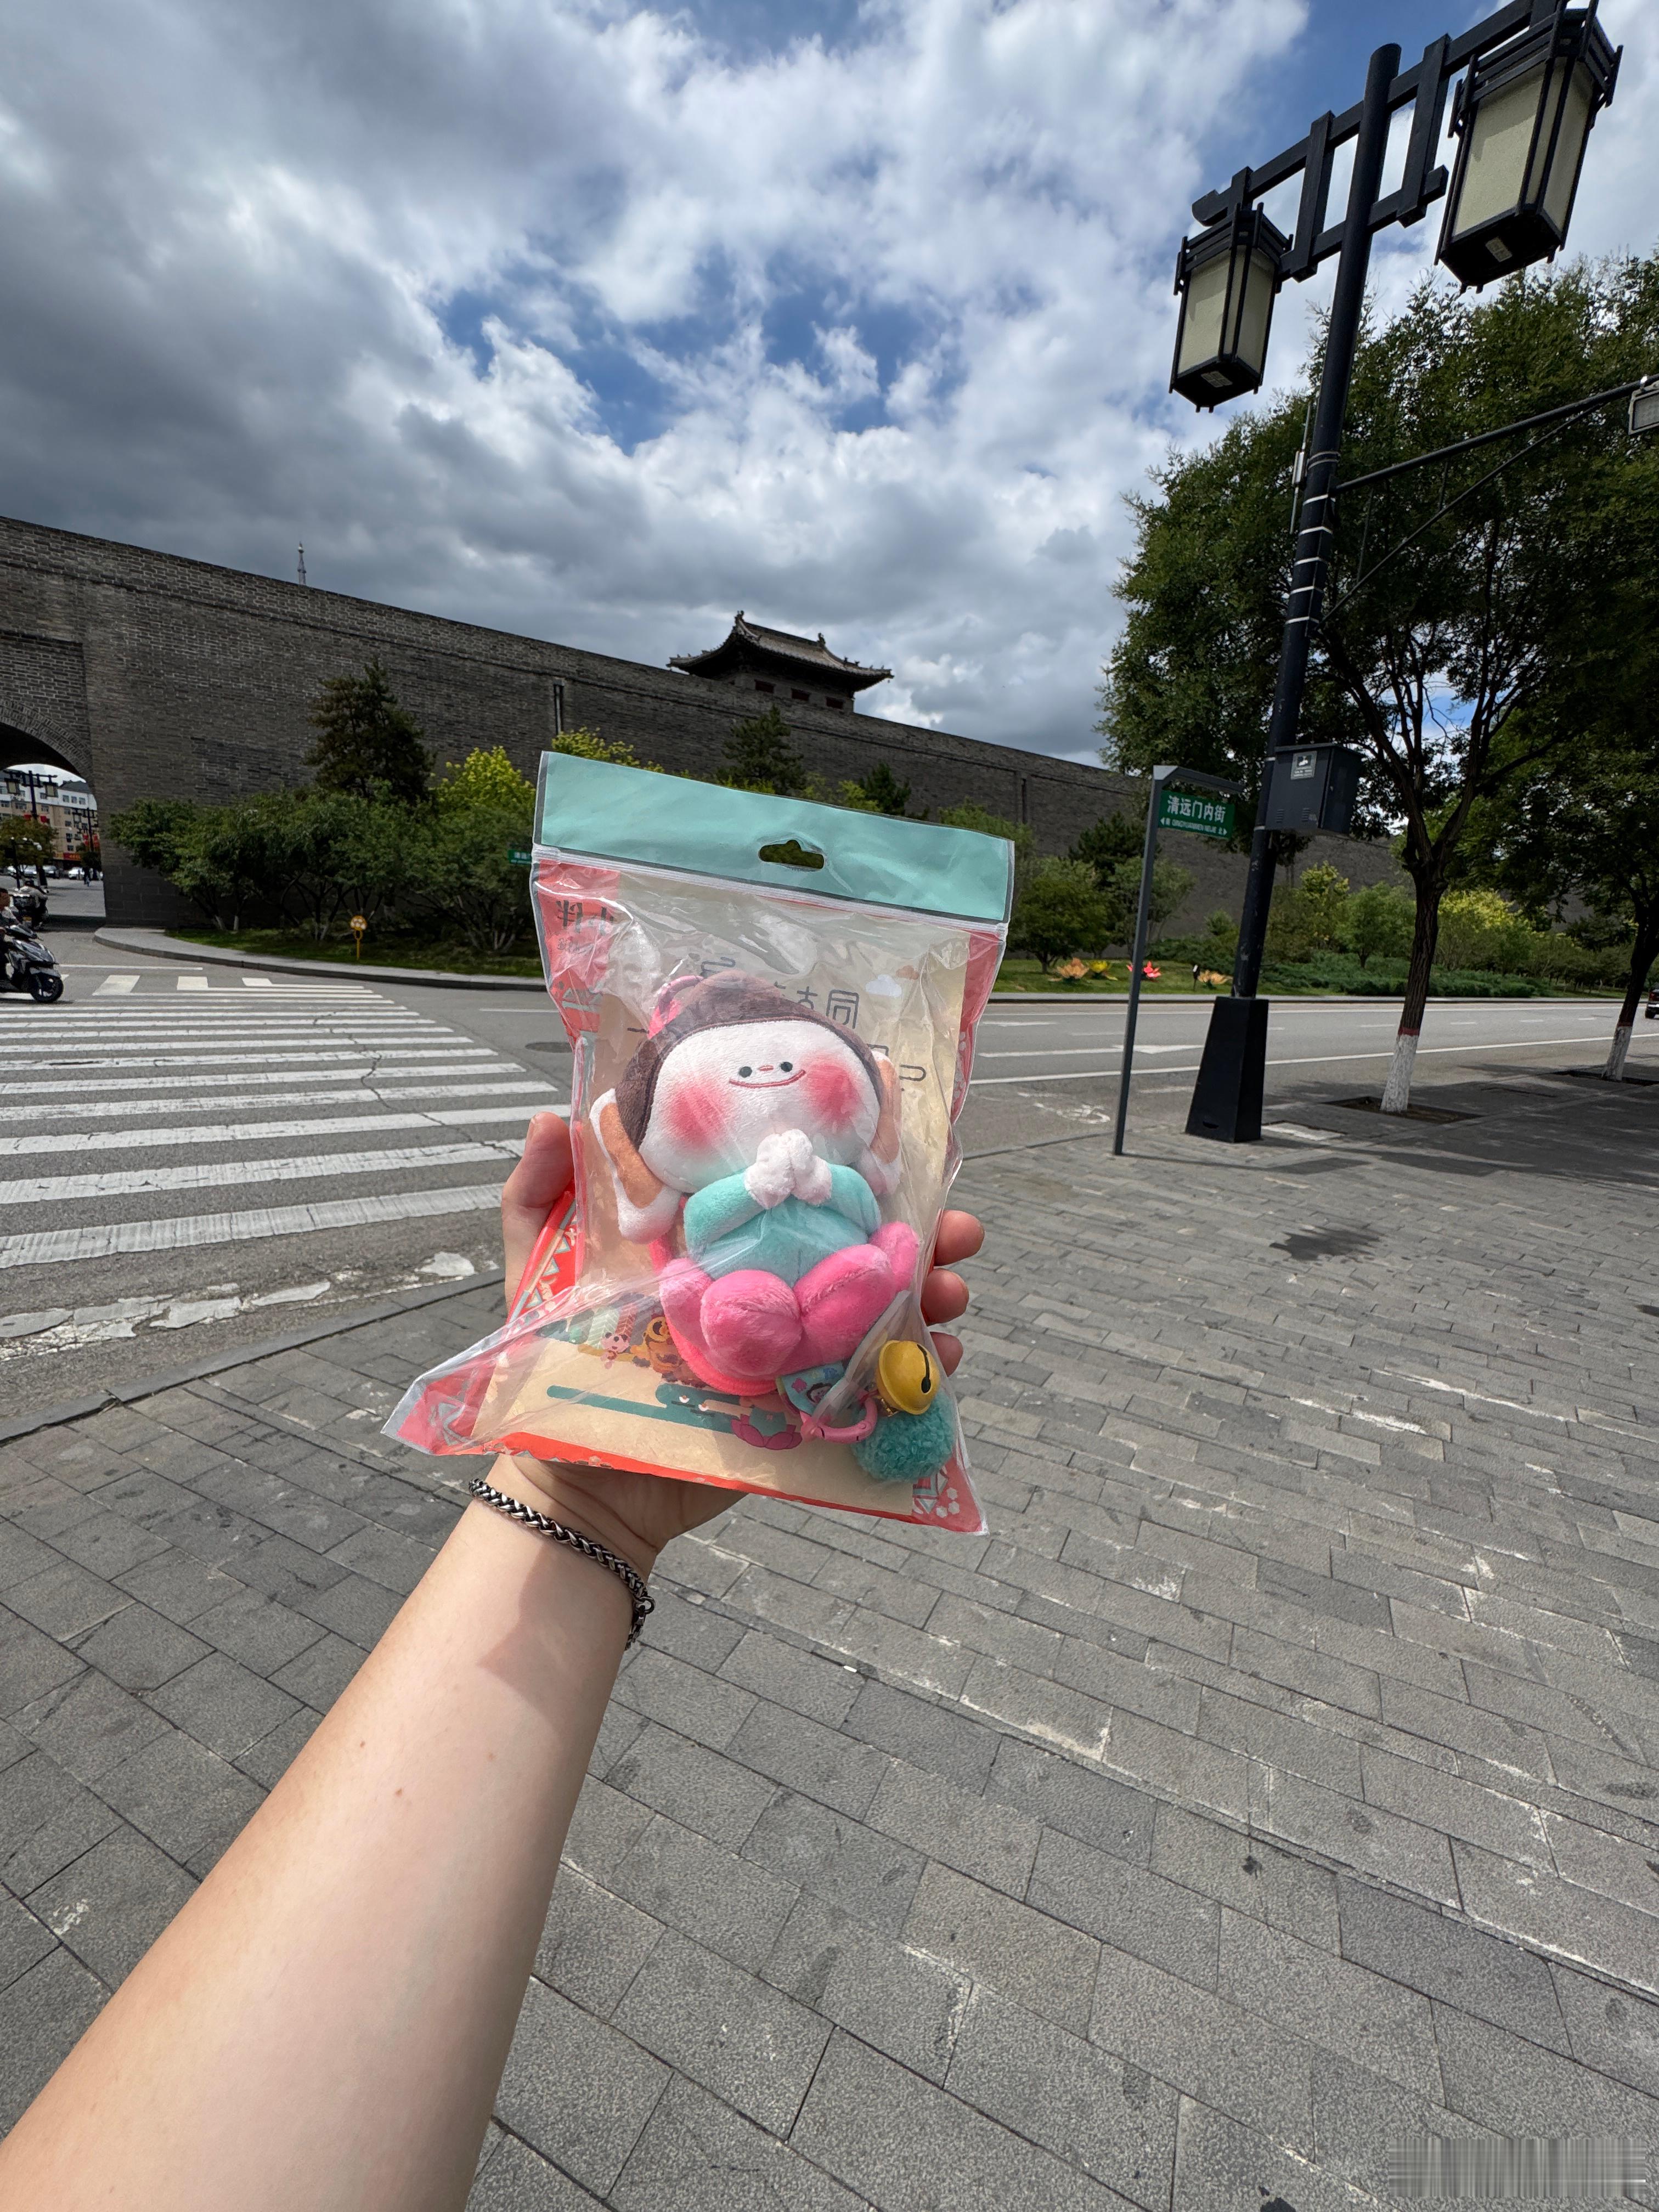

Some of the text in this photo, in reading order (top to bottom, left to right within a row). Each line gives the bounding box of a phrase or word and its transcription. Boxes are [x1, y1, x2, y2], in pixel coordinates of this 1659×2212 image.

[1167, 795, 1226, 823] 清远门内街
